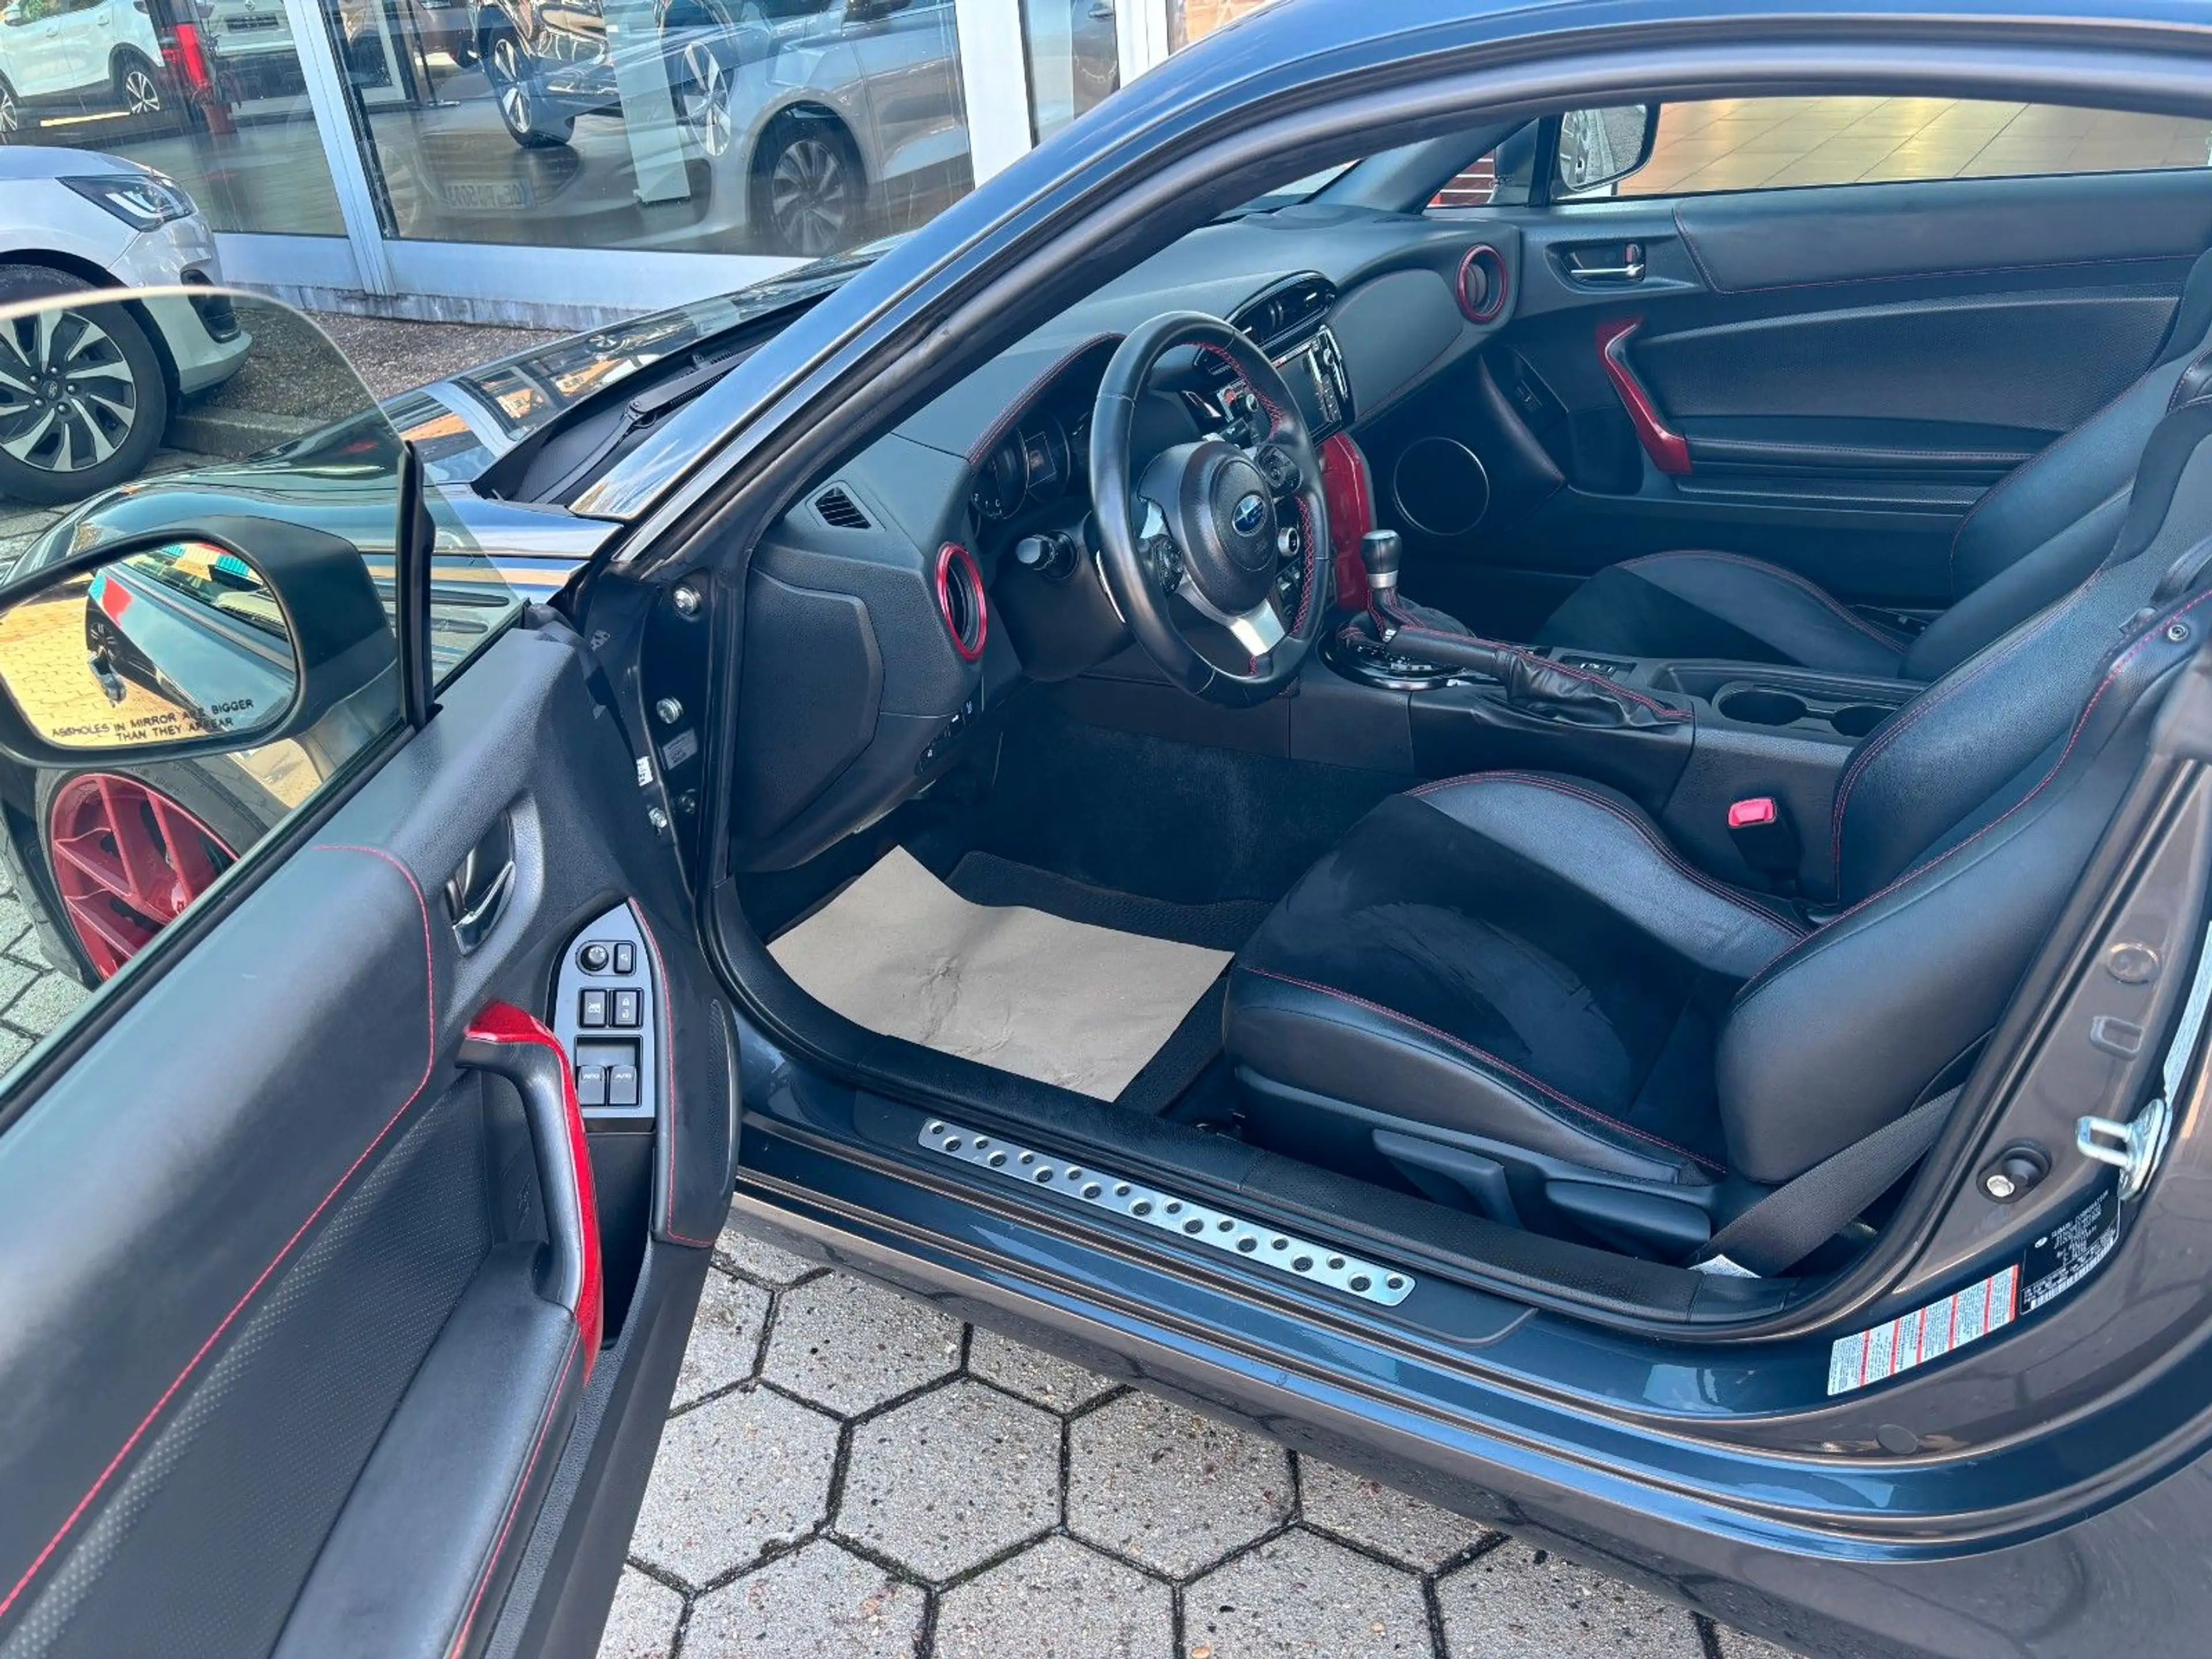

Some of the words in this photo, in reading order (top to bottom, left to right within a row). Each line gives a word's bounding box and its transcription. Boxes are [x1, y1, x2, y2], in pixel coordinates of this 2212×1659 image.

[52, 723, 110, 738] ASSHOLES
[115, 721, 126, 732] IN
[130, 713, 177, 729] MIRROR
[183, 707, 204, 721] ARE
[211, 699, 255, 715] BIGGER
[116, 730, 148, 742] THAN
[151, 724, 183, 738] THEY
[189, 717, 234, 732] APPEAR
